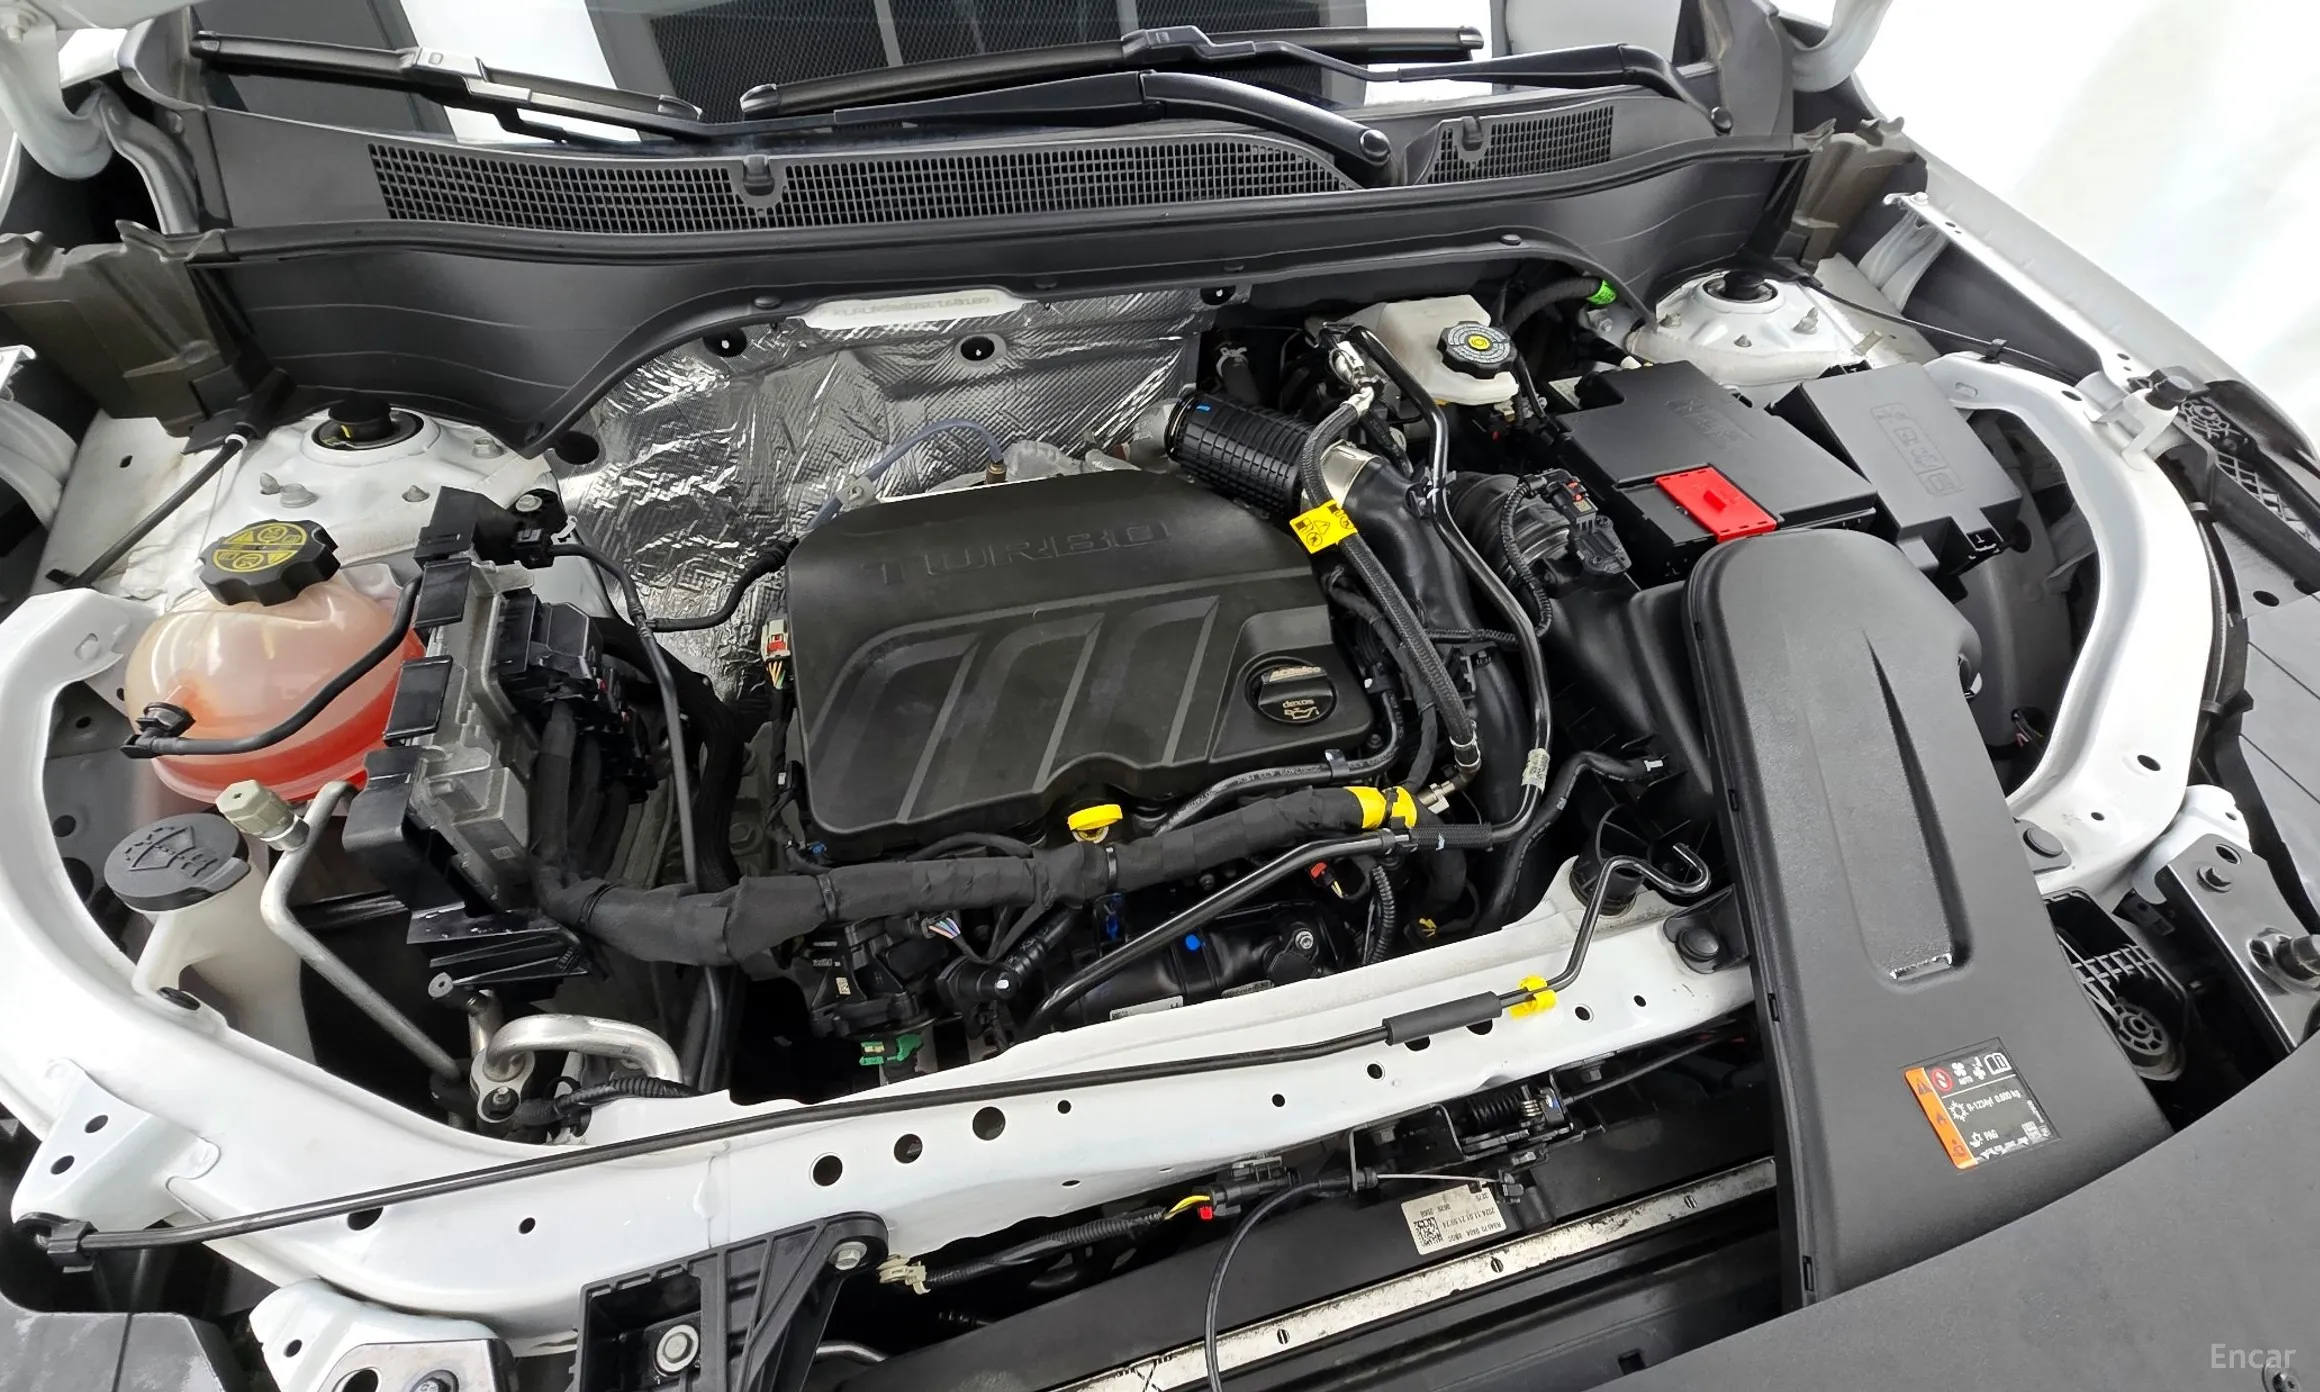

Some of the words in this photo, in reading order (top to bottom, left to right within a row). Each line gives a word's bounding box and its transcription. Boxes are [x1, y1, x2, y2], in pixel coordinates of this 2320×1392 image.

[860, 522, 1170, 585] TURBO
[1283, 699, 1315, 709] dexos
[1984, 1129, 1999, 1141] PAG
